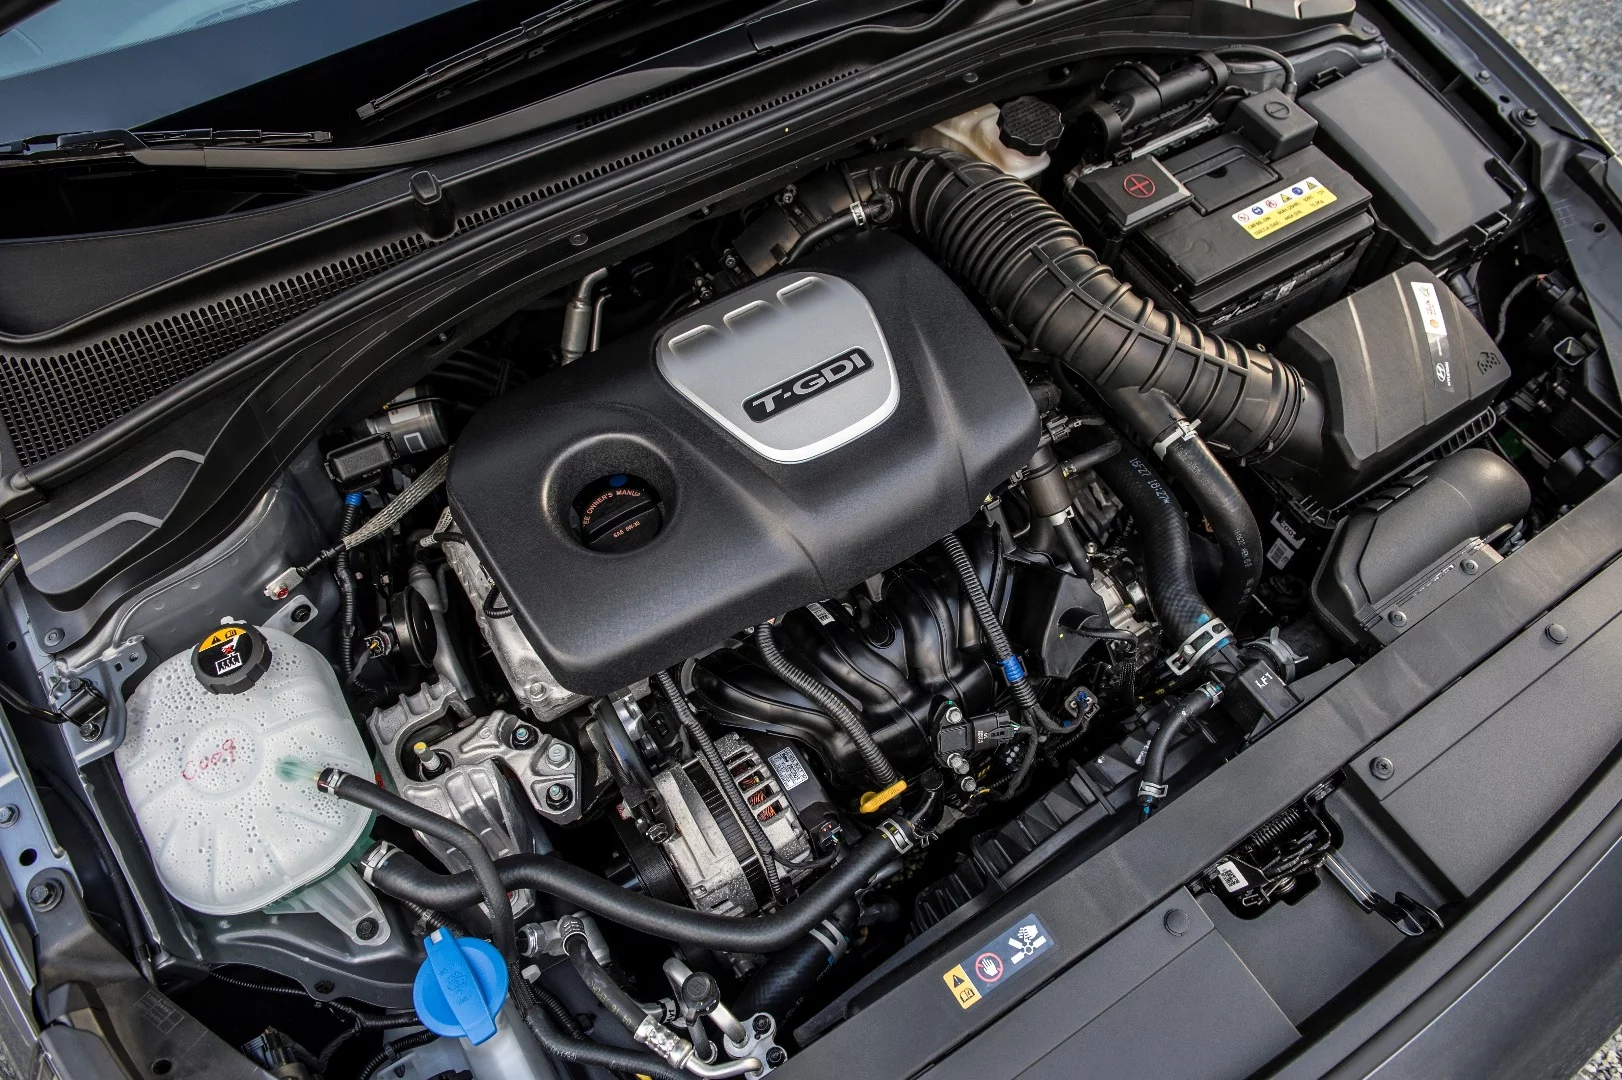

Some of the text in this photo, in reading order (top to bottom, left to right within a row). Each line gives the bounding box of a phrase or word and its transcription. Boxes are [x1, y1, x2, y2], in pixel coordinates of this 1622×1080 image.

[752, 352, 866, 413] T-GDI
[1129, 457, 1152, 477] 16F27
[586, 491, 613, 515] OWNER'S
[582, 515, 591, 528] EE
[1254, 671, 1274, 690] LF1
